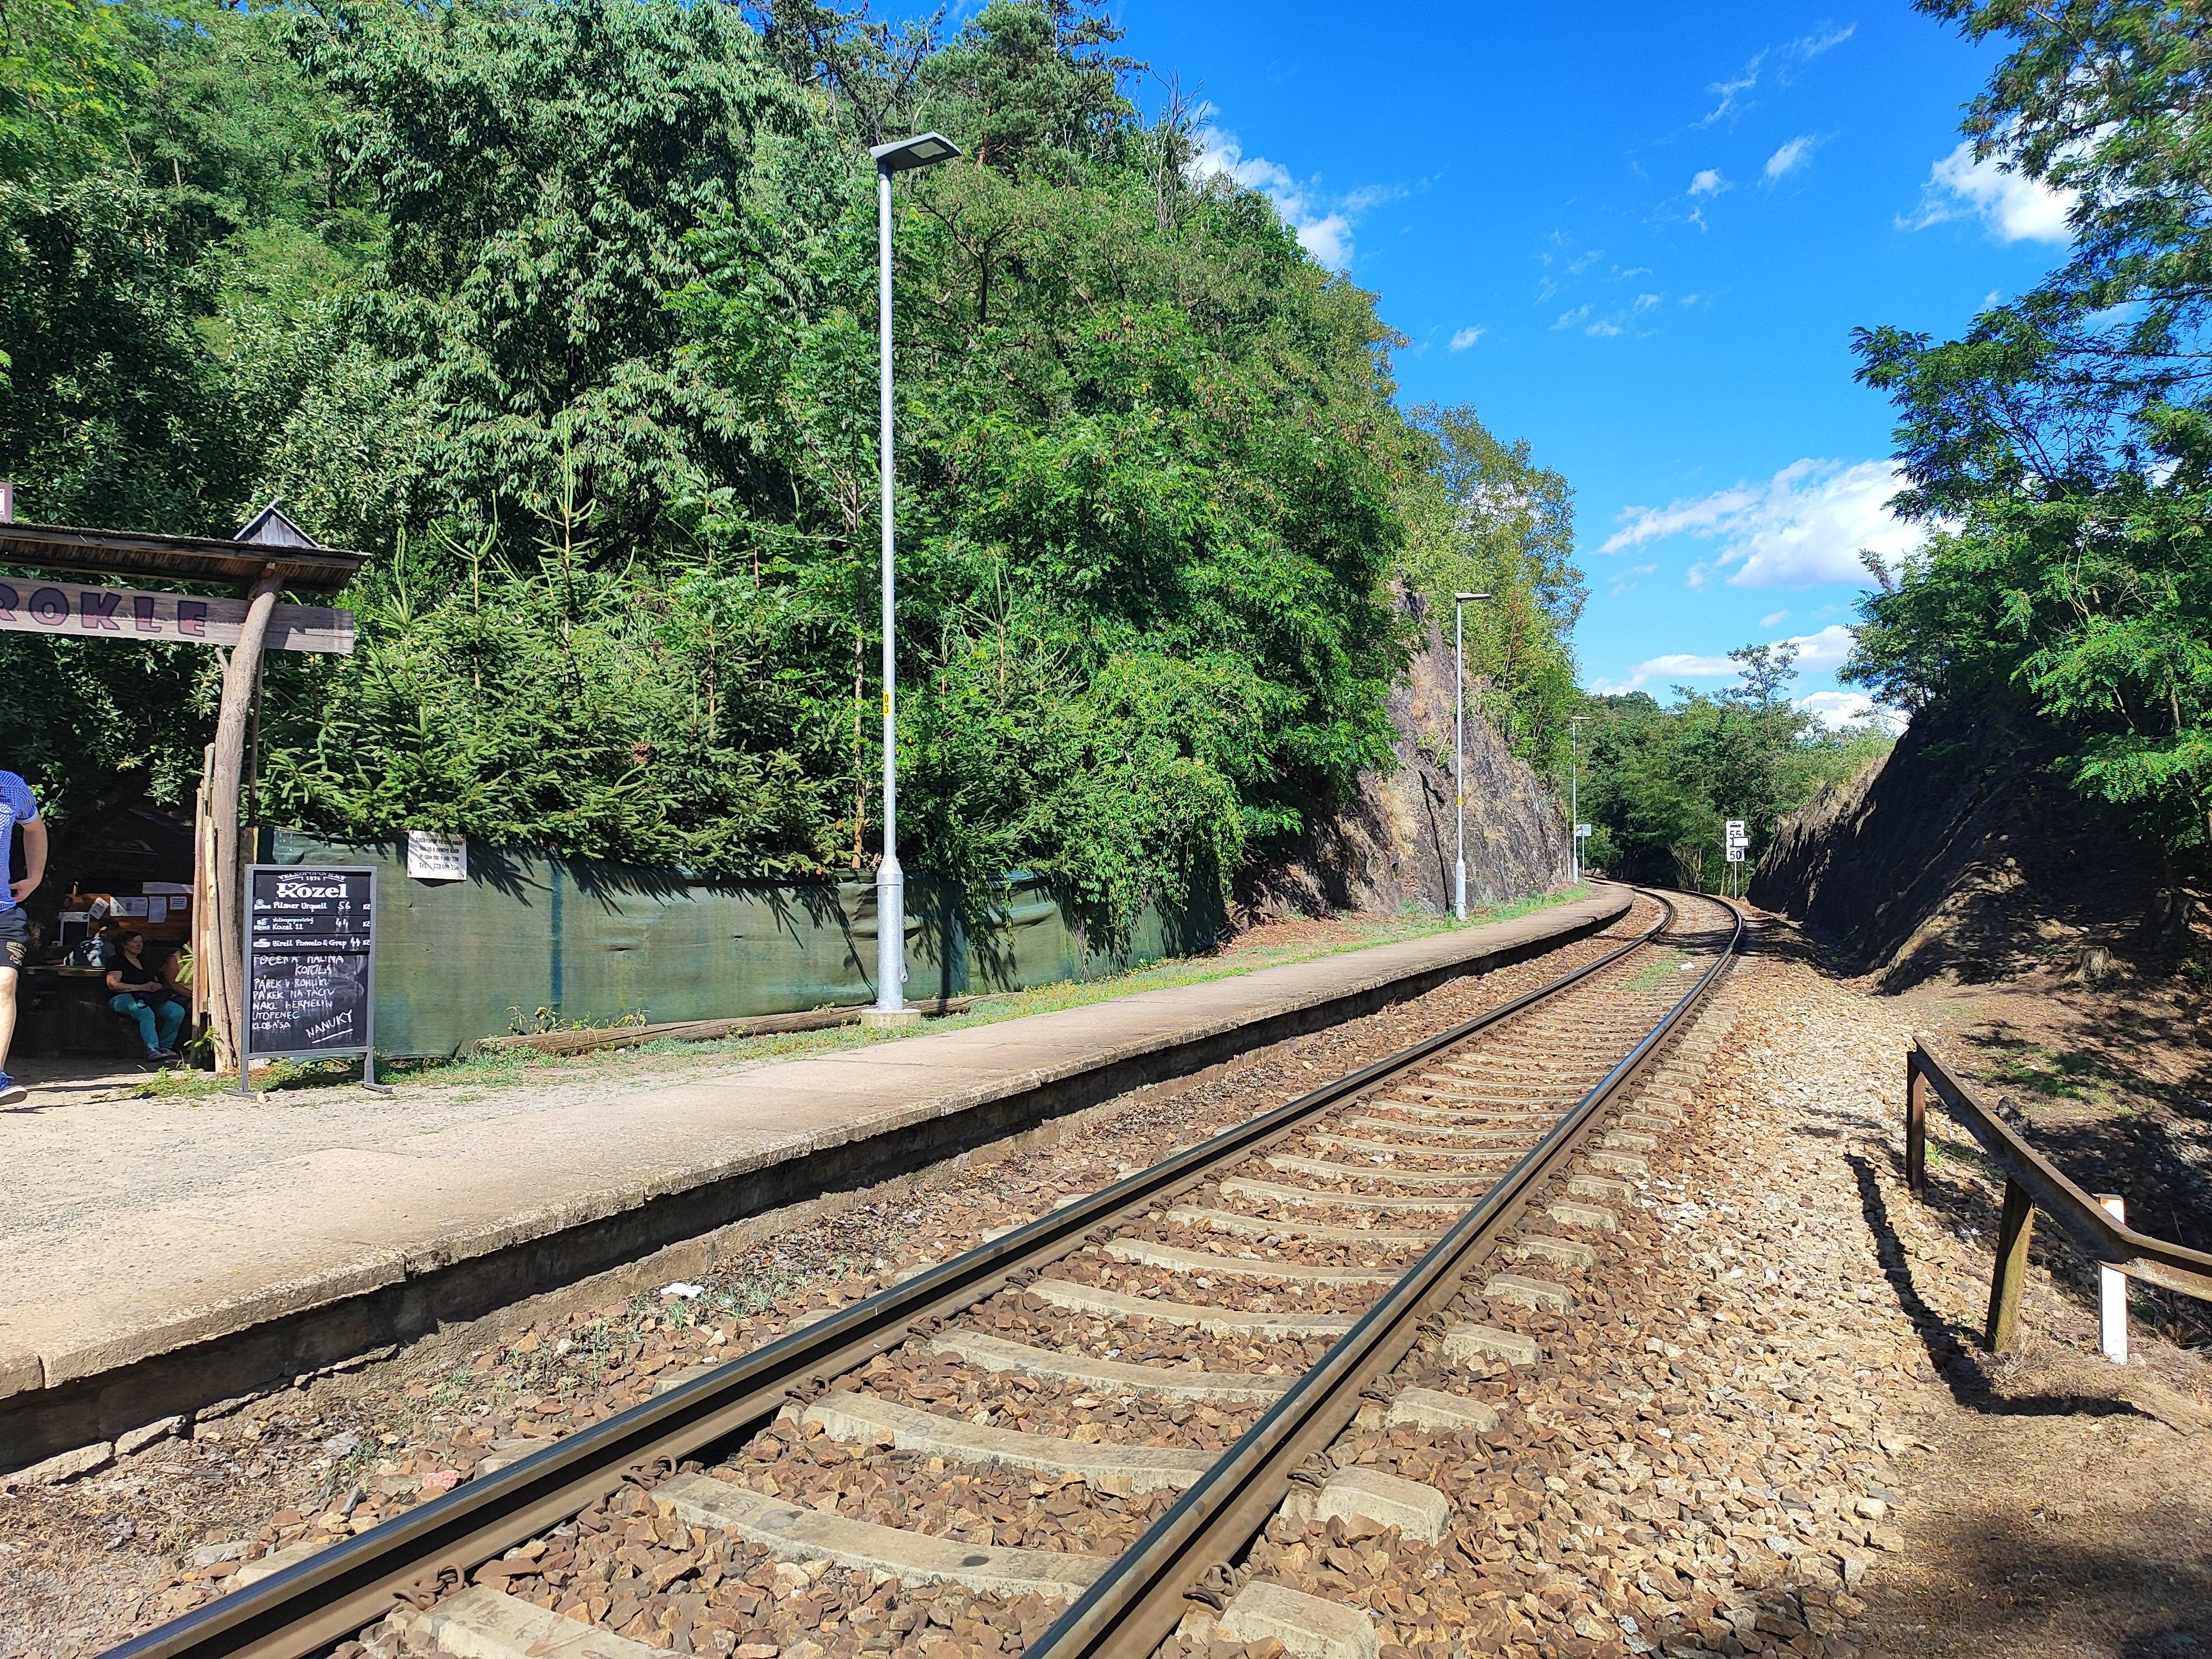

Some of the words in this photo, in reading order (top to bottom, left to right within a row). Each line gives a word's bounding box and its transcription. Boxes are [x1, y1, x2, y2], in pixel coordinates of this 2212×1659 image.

[1730, 851, 1742, 860] 50
[276, 883, 349, 898] Kozel
[273, 901, 300, 909] Pilsner
[301, 901, 328, 912] Urquell
[337, 901, 351, 910] 56
[272, 939, 294, 947] Birell
[328, 939, 347, 950] Grep
[290, 989, 303, 999] NA
[252, 1011, 301, 1021] UTOPENEC
[305, 1009, 353, 1039] NANUKY
